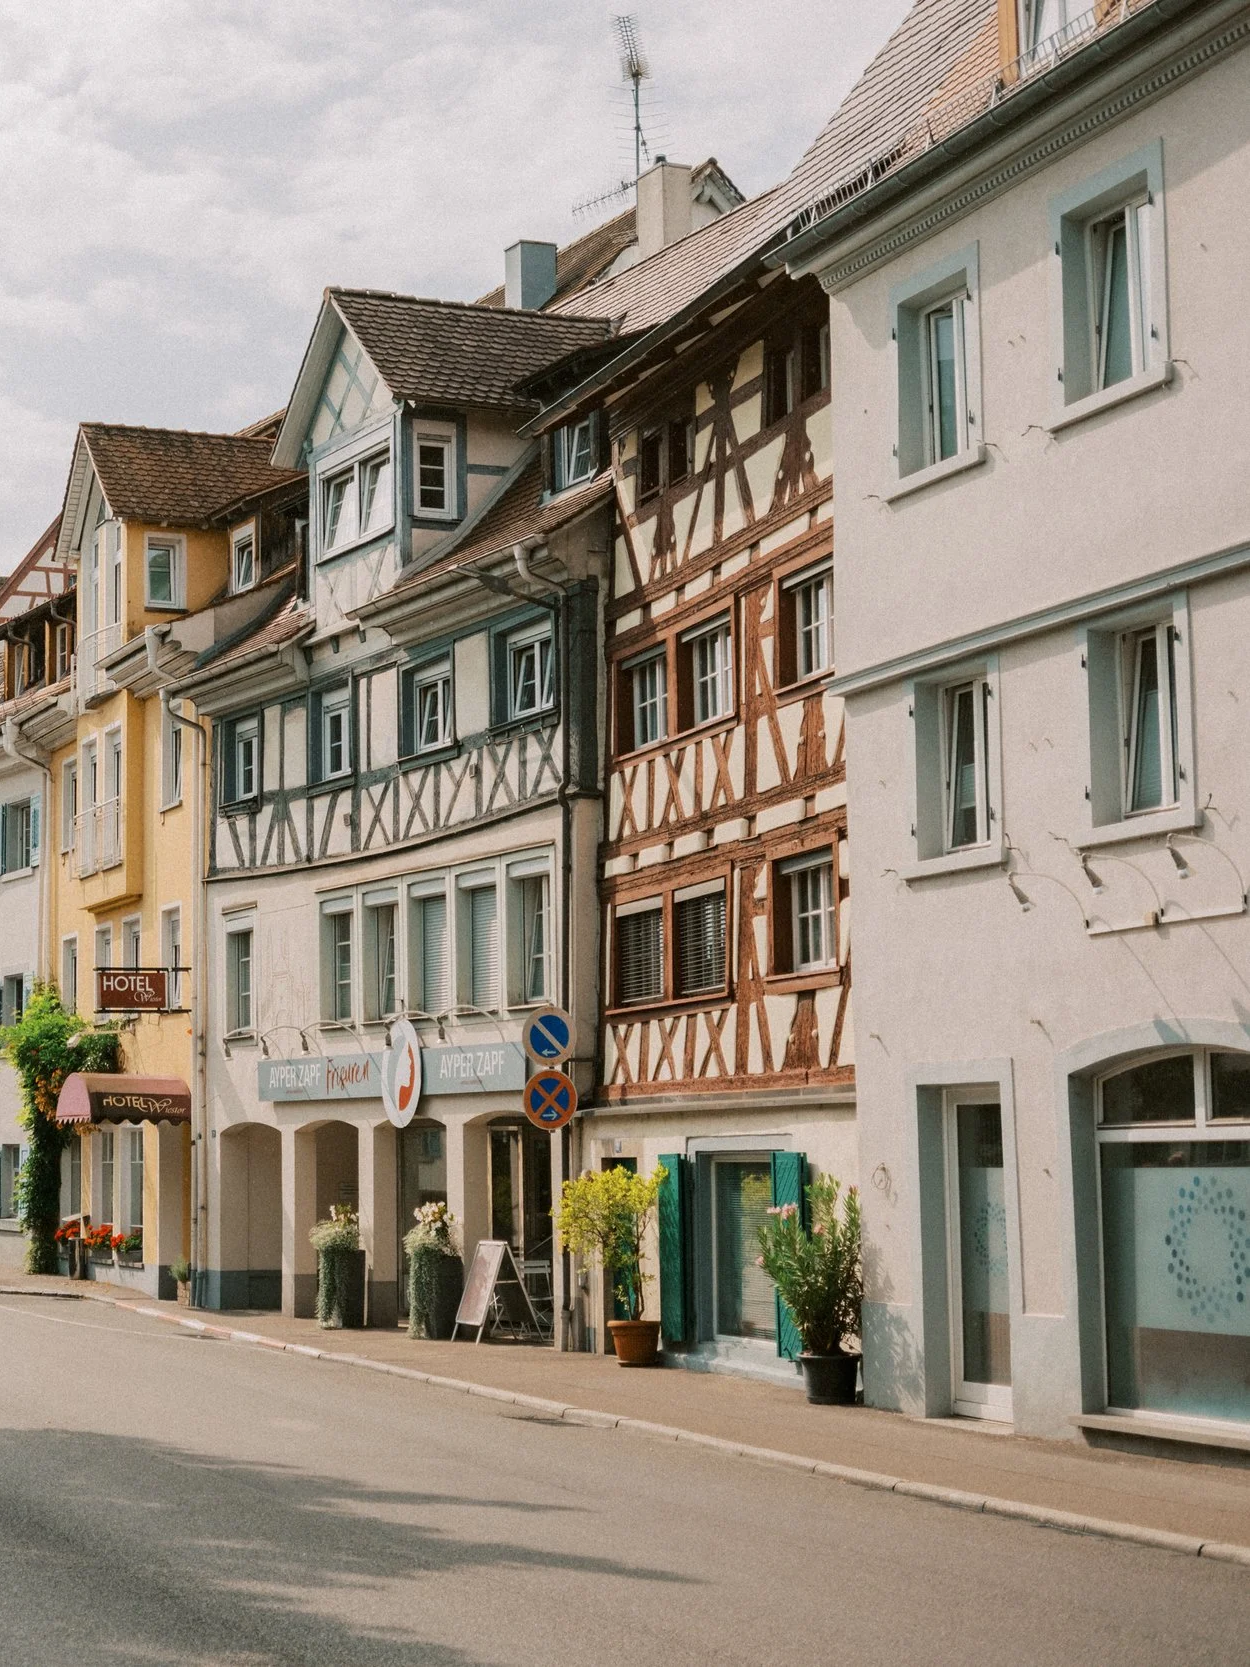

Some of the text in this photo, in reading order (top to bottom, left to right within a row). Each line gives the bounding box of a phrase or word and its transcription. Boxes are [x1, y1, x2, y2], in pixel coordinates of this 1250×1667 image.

[103, 975, 153, 992] HOTEL
[439, 1050, 505, 1079] AYPER ZAPF
[270, 1065, 297, 1088] AYPER
[298, 1063, 321, 1087] ZAPF
[102, 1096, 148, 1108] HOTEL
